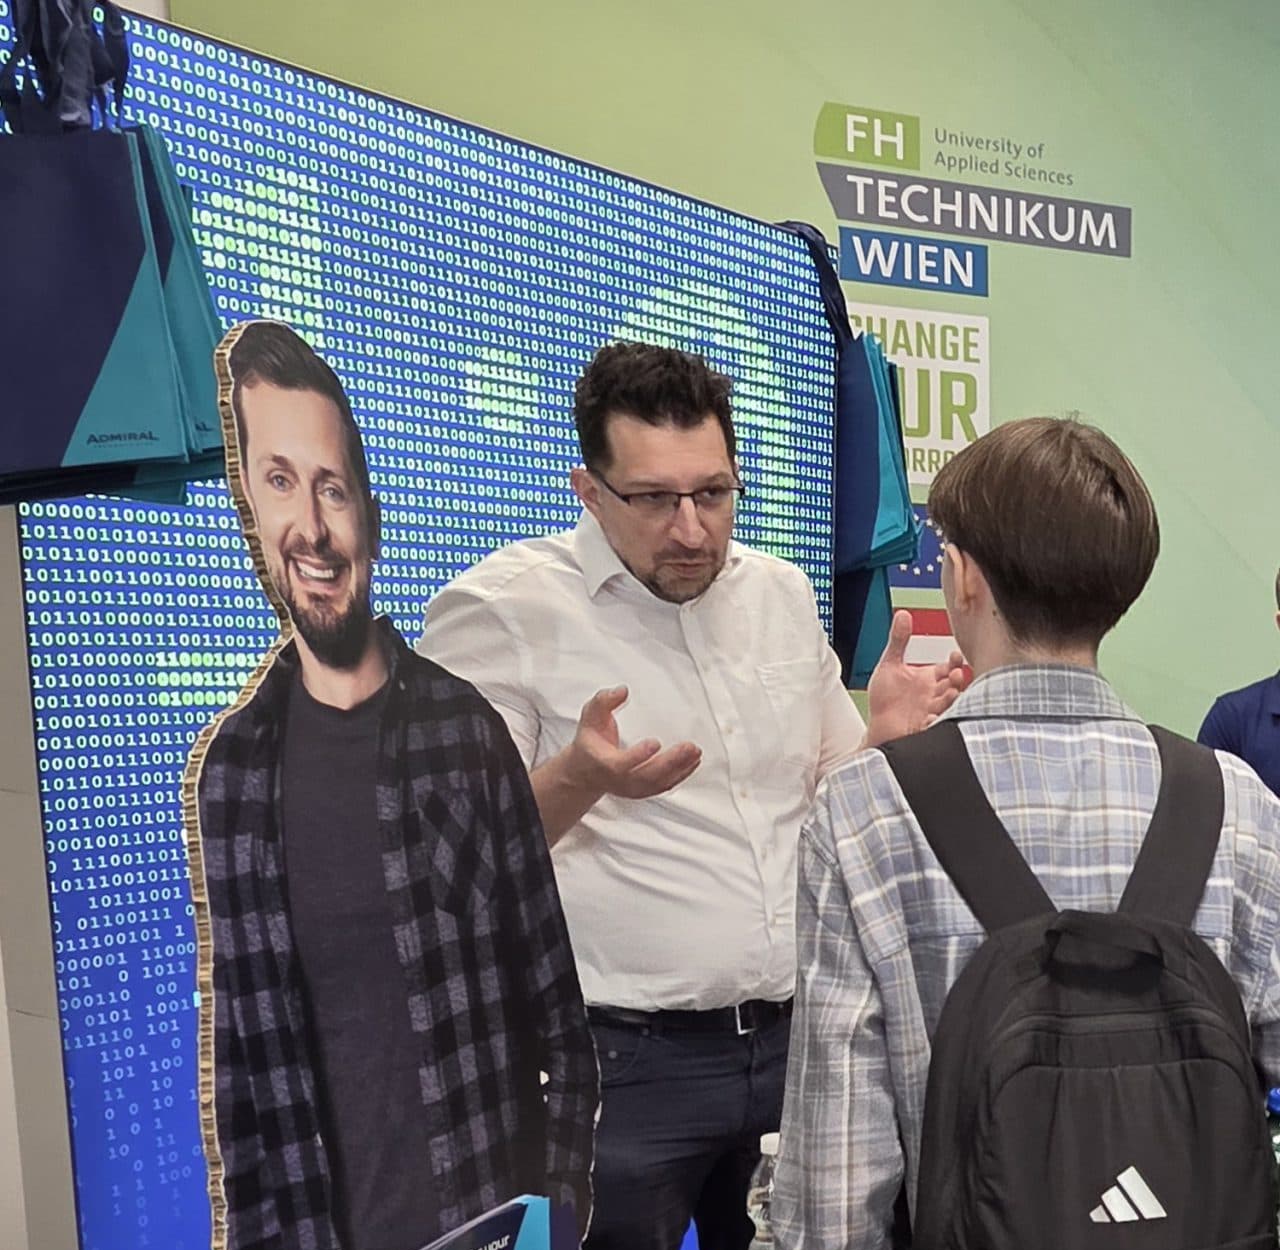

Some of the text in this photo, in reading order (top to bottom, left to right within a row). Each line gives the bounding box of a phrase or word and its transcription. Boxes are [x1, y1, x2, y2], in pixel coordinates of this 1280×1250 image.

[846, 114, 905, 161] FH
[935, 127, 1046, 160] University of
[935, 152, 1074, 186] Applied Sciences
[846, 175, 1118, 249] TECHNIKUM
[852, 236, 973, 288] WIEN
[87, 430, 160, 445] ADMIRAL
